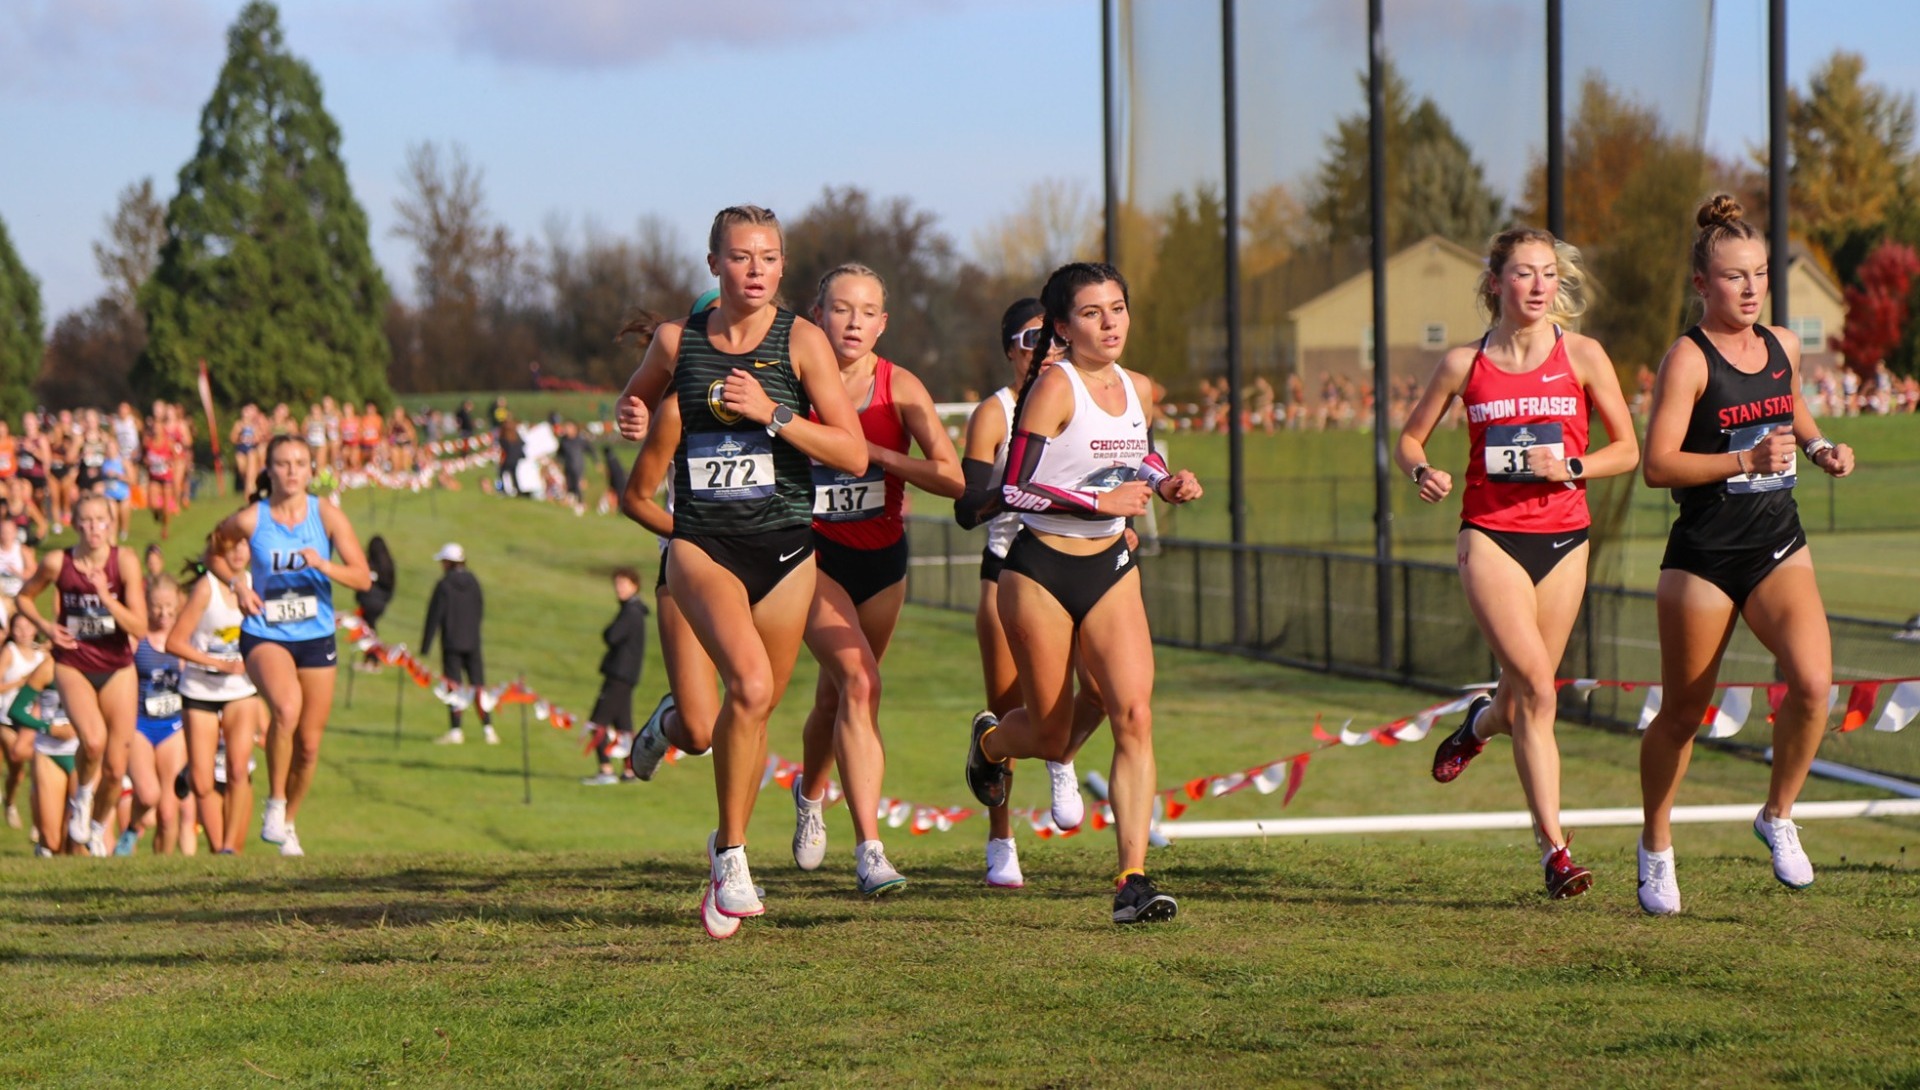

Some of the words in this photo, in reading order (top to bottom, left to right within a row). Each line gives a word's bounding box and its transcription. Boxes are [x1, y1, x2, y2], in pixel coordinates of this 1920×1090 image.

[1469, 399, 1516, 423] SIMON
[1519, 397, 1577, 416] FRASER
[1718, 401, 1762, 427] STAN
[1764, 394, 1794, 416] STAT
[1090, 439, 1125, 451] CHICO
[705, 458, 757, 488] 272
[1503, 449, 1532, 473] 31
[825, 486, 868, 512] 137
[277, 601, 306, 620] 353
